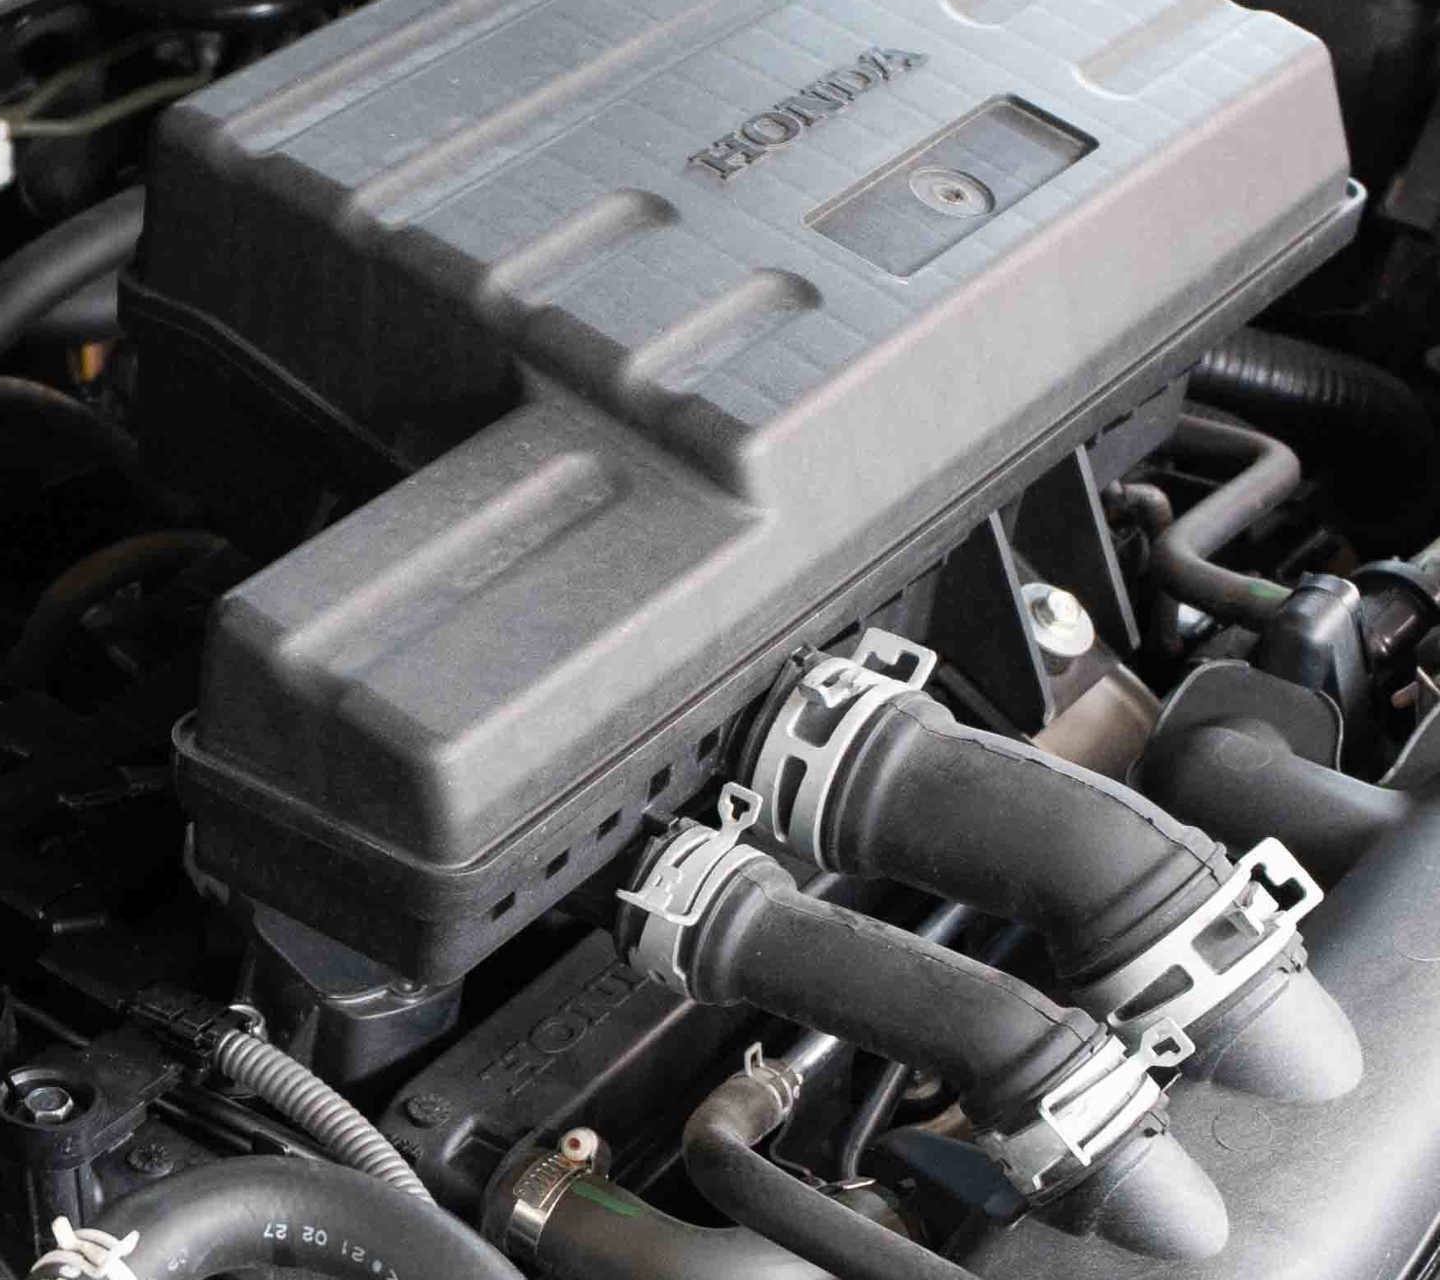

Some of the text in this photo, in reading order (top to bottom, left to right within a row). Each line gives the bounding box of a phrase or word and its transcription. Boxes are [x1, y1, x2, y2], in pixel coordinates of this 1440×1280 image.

[687, 47, 928, 181] HONDA
[263, 1223, 288, 1240] 27
[302, 1225, 328, 1247] 02
[341, 1240, 366, 1263] 21
